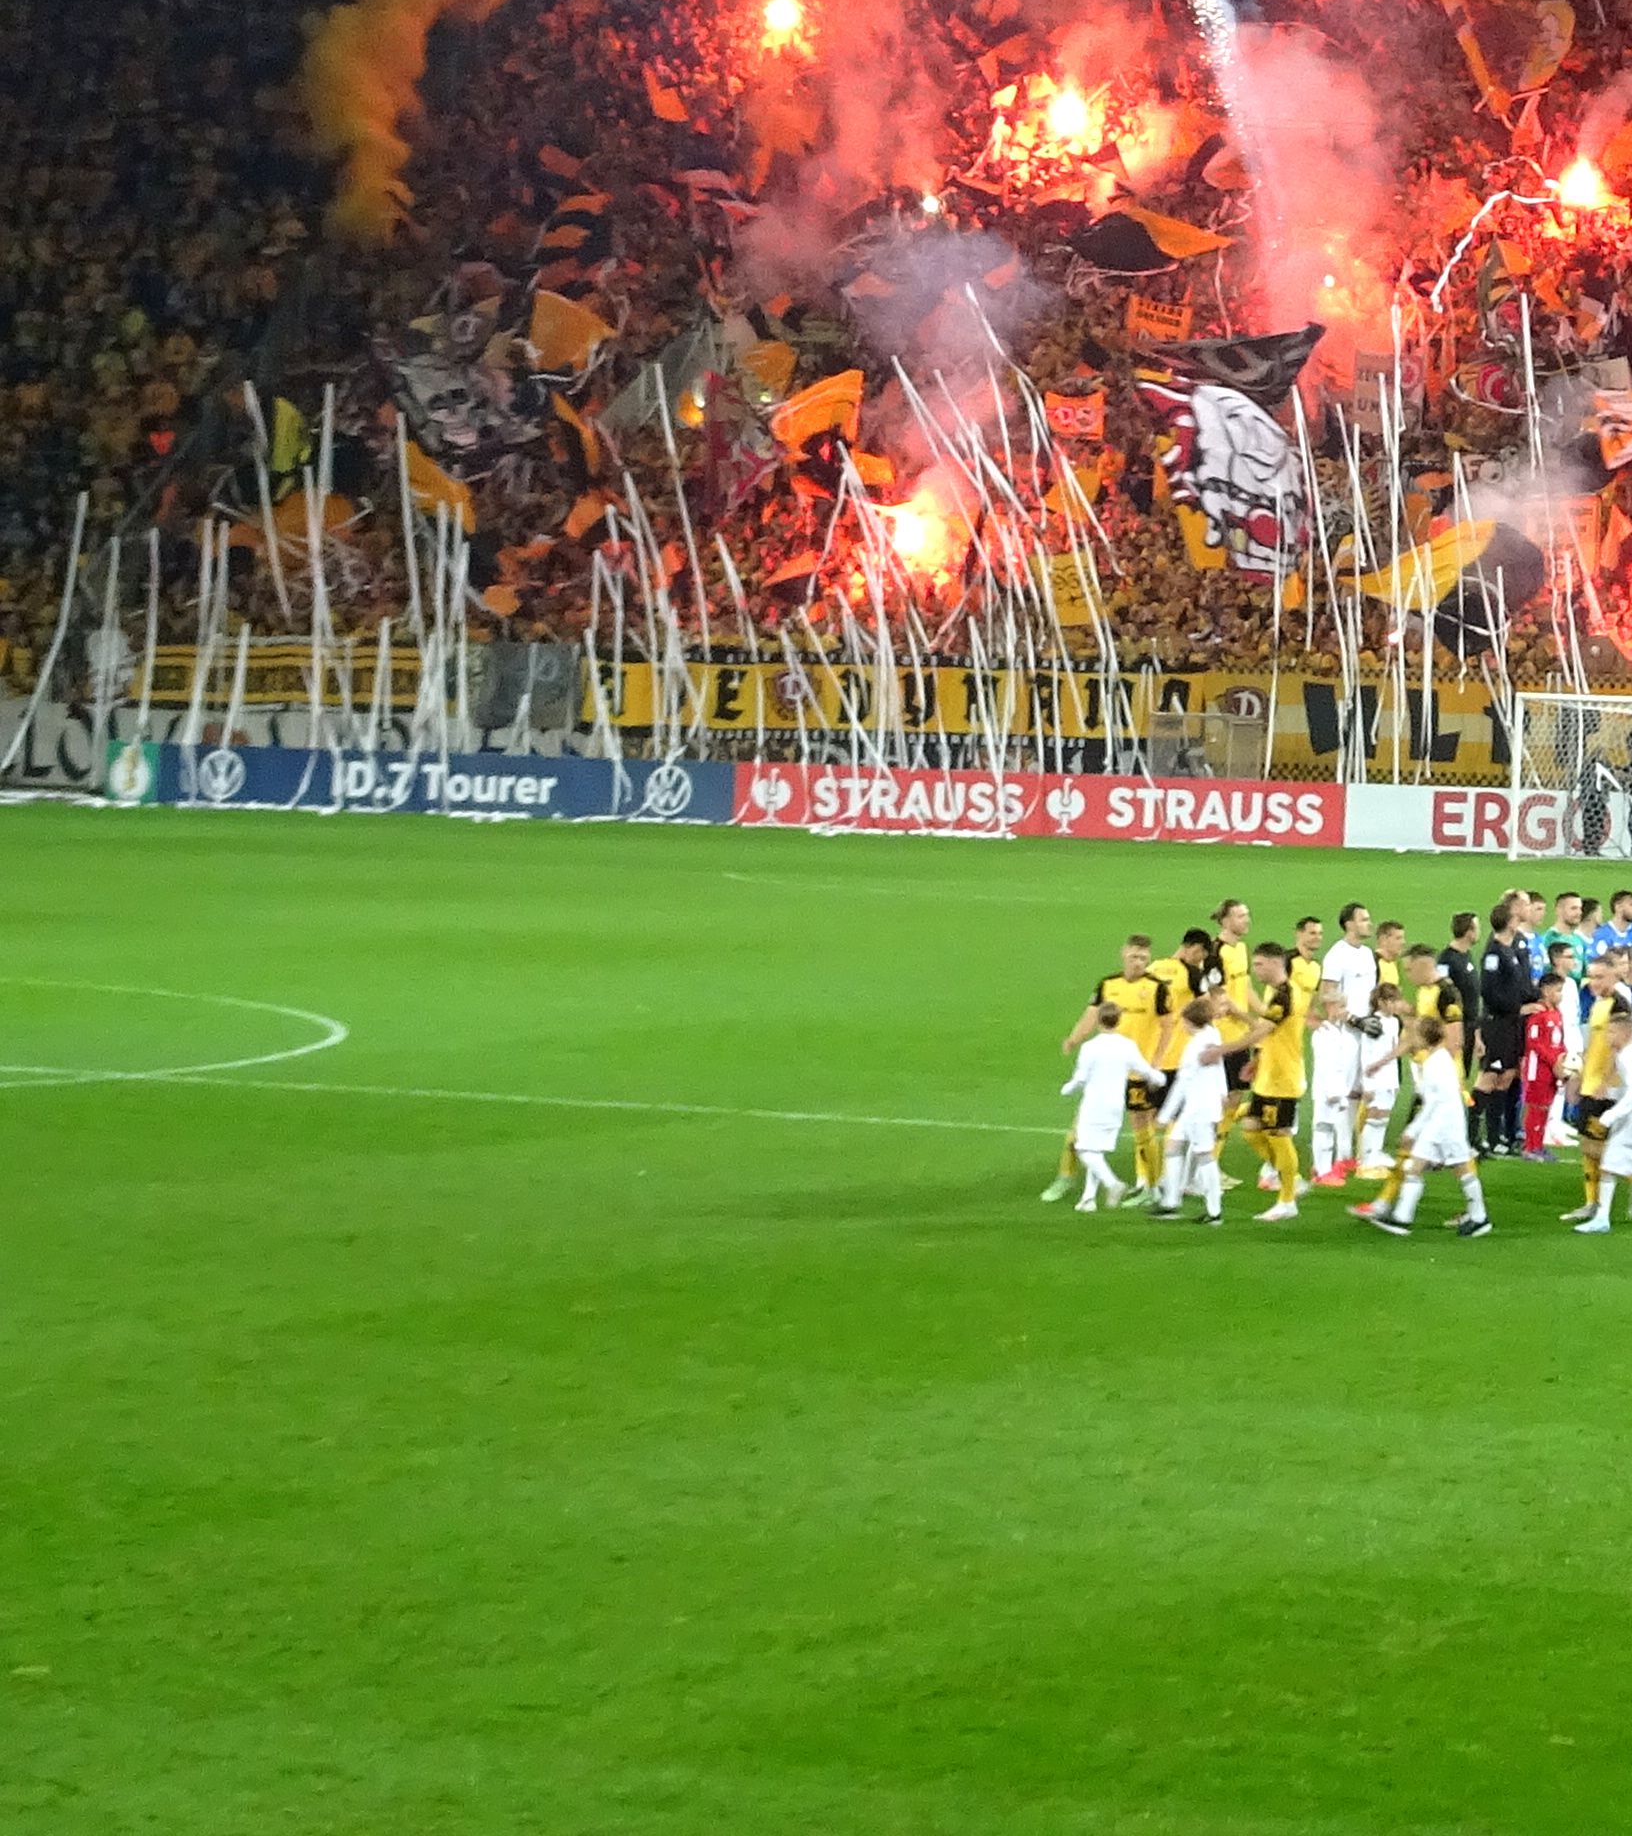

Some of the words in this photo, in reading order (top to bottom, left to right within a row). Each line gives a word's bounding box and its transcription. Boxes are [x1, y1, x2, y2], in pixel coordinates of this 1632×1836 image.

[420, 763, 559, 805] Tourer
[812, 775, 1025, 826] STRAUSS
[1105, 784, 1325, 837] STRAUSS
[1431, 790, 1612, 852] ERGO
